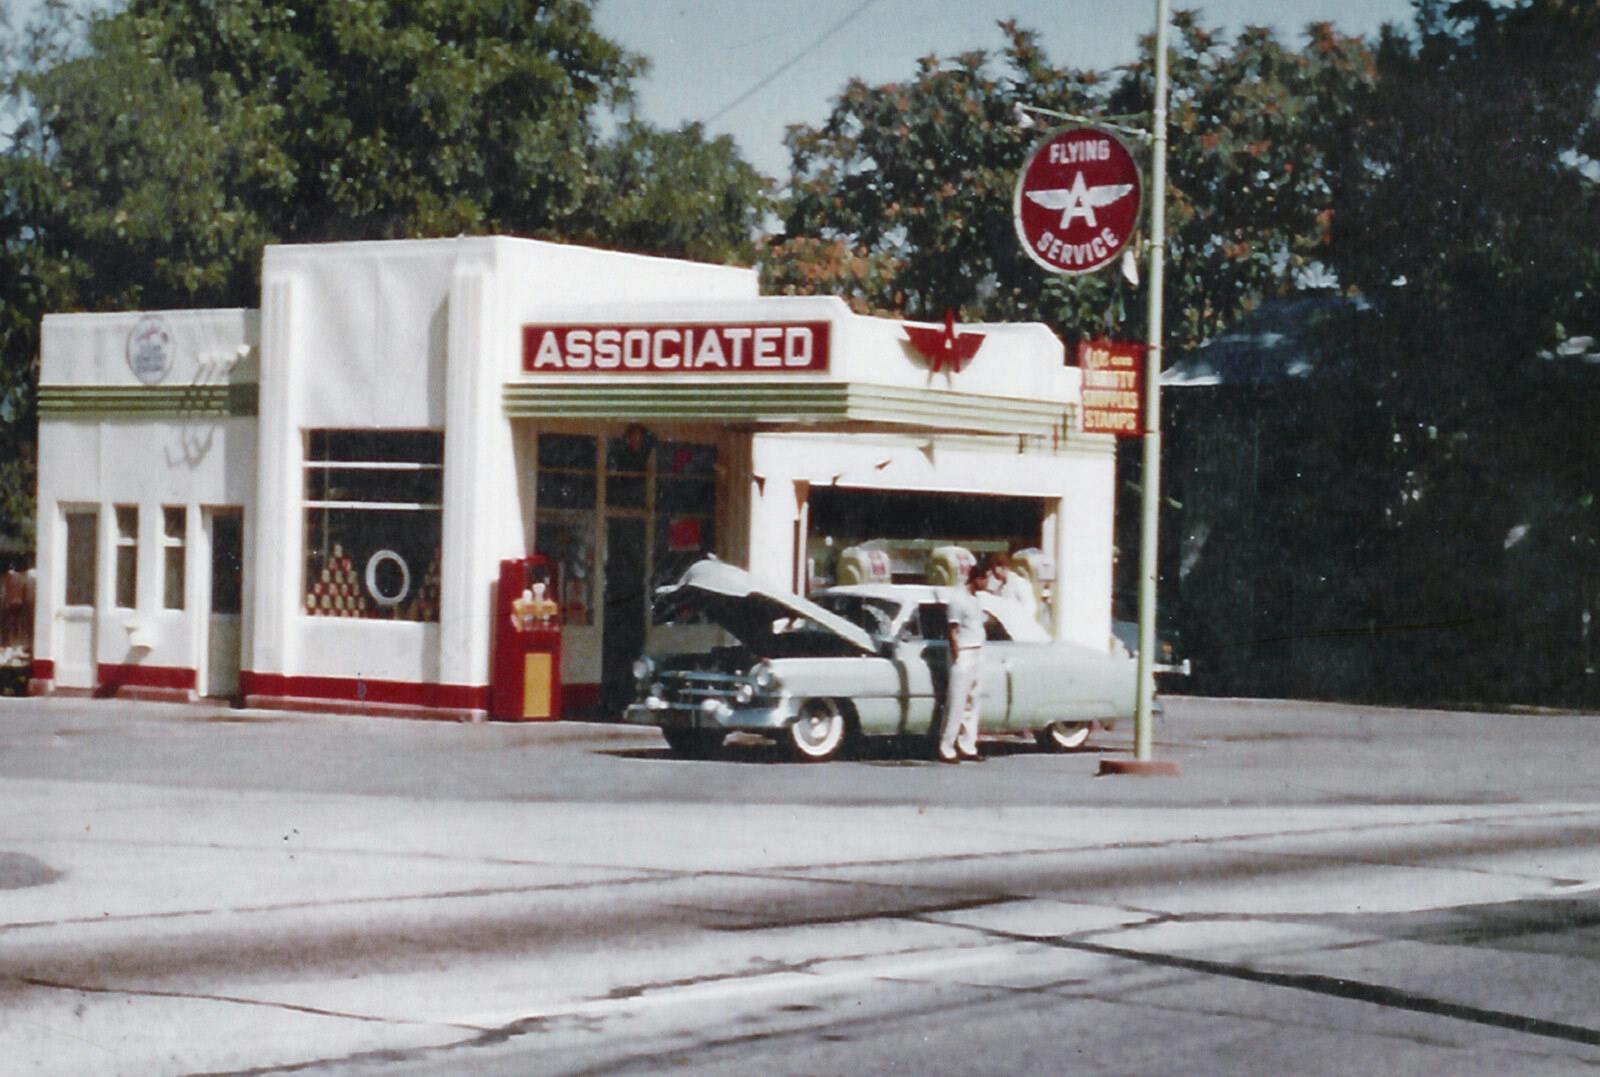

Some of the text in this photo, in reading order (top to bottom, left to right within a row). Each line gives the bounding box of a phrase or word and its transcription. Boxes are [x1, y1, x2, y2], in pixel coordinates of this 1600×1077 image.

[1050, 140, 1110, 164] FLYING
[1037, 227, 1119, 264] SERVICE
[533, 327, 813, 368] ASSOCIATED
[1085, 411, 1136, 431] STAMPS
